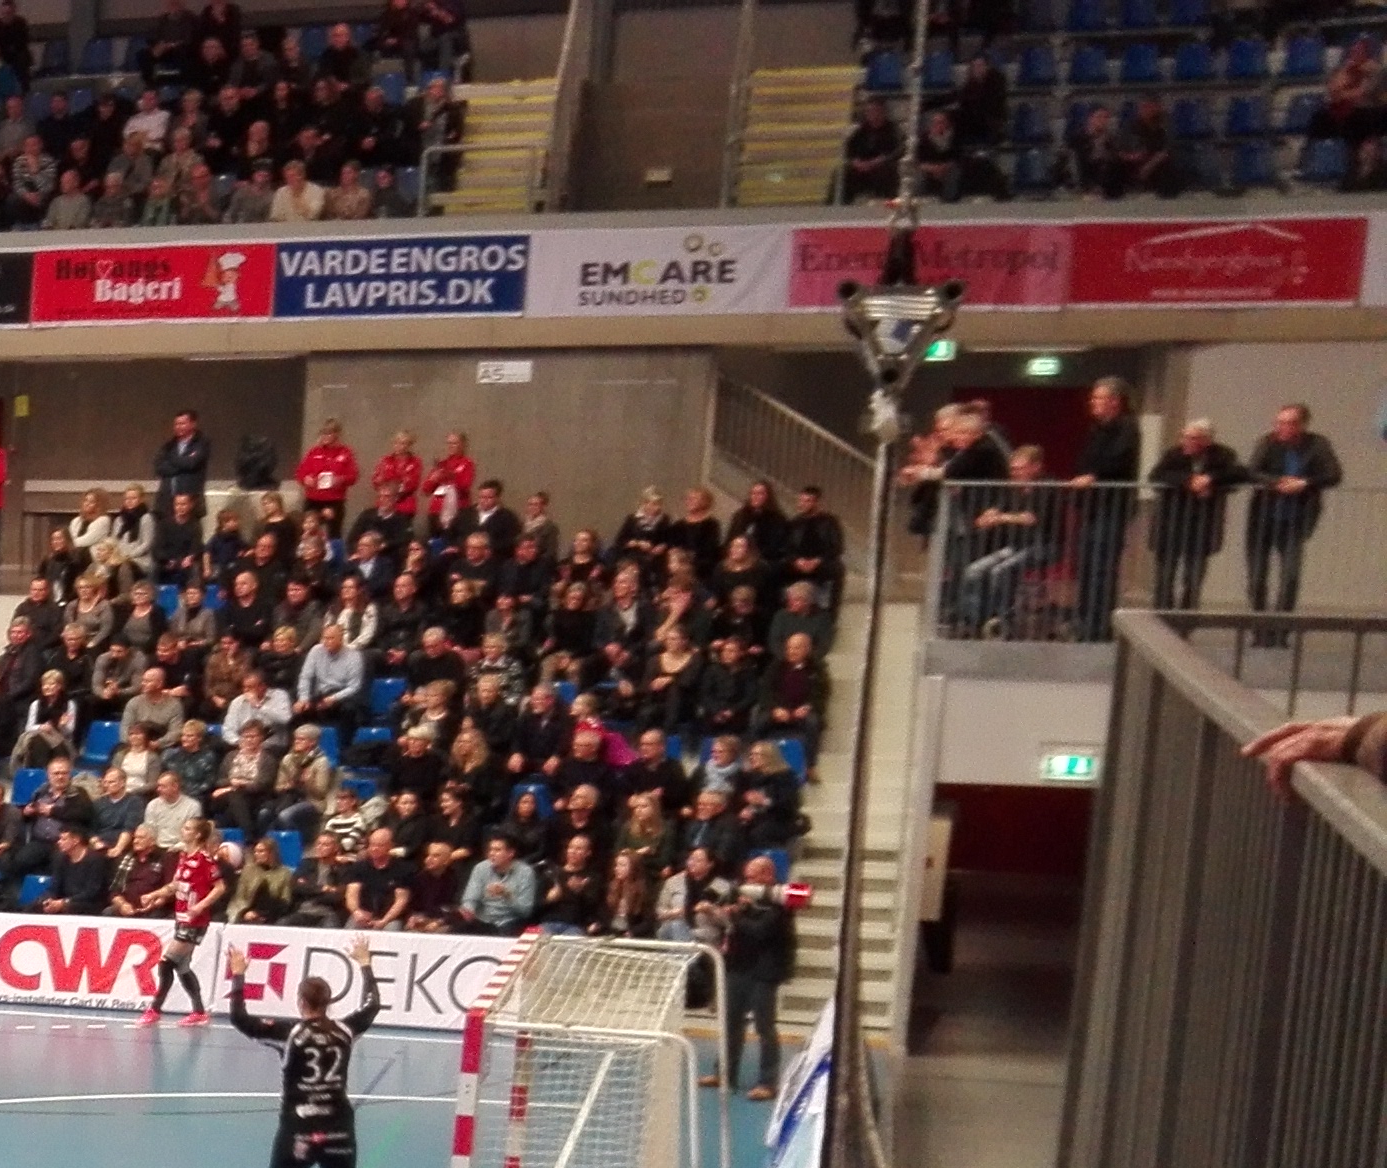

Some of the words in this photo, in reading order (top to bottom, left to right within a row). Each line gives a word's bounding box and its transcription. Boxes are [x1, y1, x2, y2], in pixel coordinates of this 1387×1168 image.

[280, 244, 526, 277] VARDEENGROS
[580, 259, 738, 287] EMCARE
[93, 277, 182, 304] Bageri
[305, 279, 494, 309] LAVPRIS.DK
[578, 287, 687, 306] SUNDHED
[302, 1047, 342, 1083] 32
